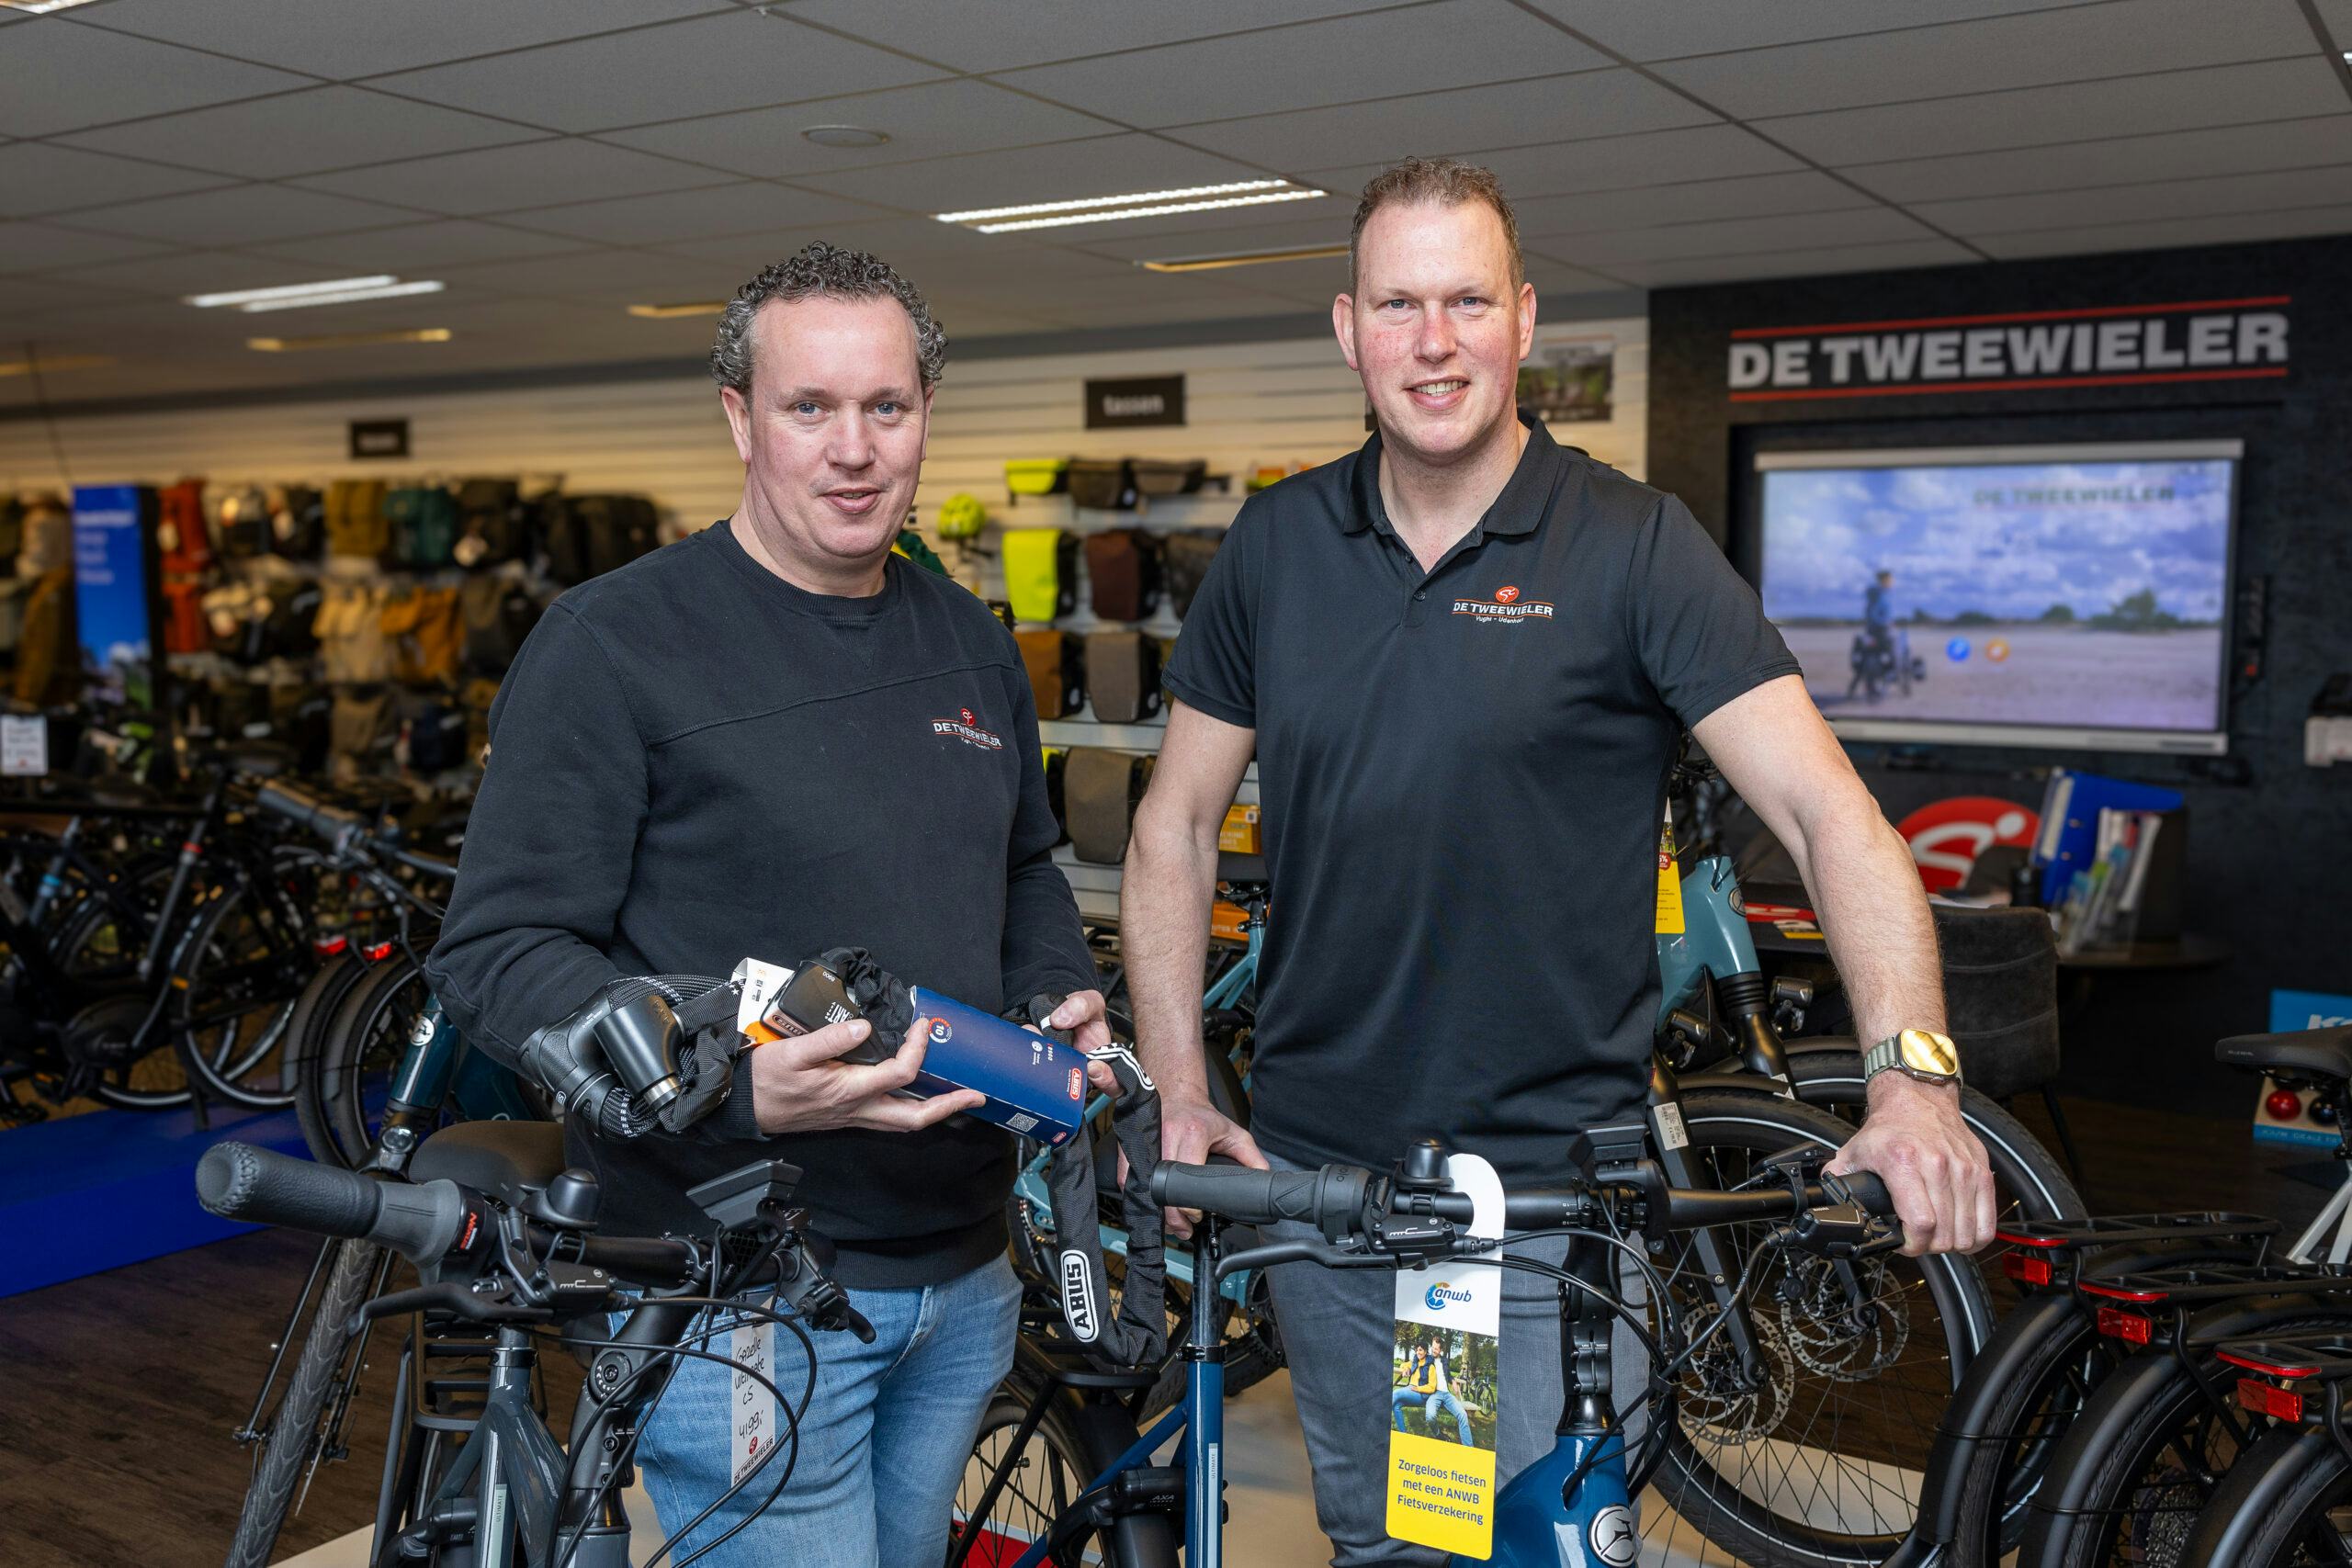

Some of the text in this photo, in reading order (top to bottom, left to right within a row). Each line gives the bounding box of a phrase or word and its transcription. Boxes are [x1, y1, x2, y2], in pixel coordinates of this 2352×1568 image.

[1728, 312, 2290, 389] DE TWEEWIELER
[1453, 602, 1554, 616] DE TWEEWIELER
[933, 722, 952, 732] DE
[952, 724, 1002, 746] TWEEWIELER
[935, 1024, 944, 1036] 10
[1072, 1072, 1080, 1096] ABUS
[1066, 1262, 1091, 1330] ABUS
[1435, 1289, 1472, 1303] anwb
[740, 1437, 774, 1479] TWEEWIELER
[1398, 1459, 1487, 1488] Zorgeloos fietsen
[1403, 1479, 1480, 1505] met een ANWB
[1397, 1494, 1484, 1526] Fietsverzekering
